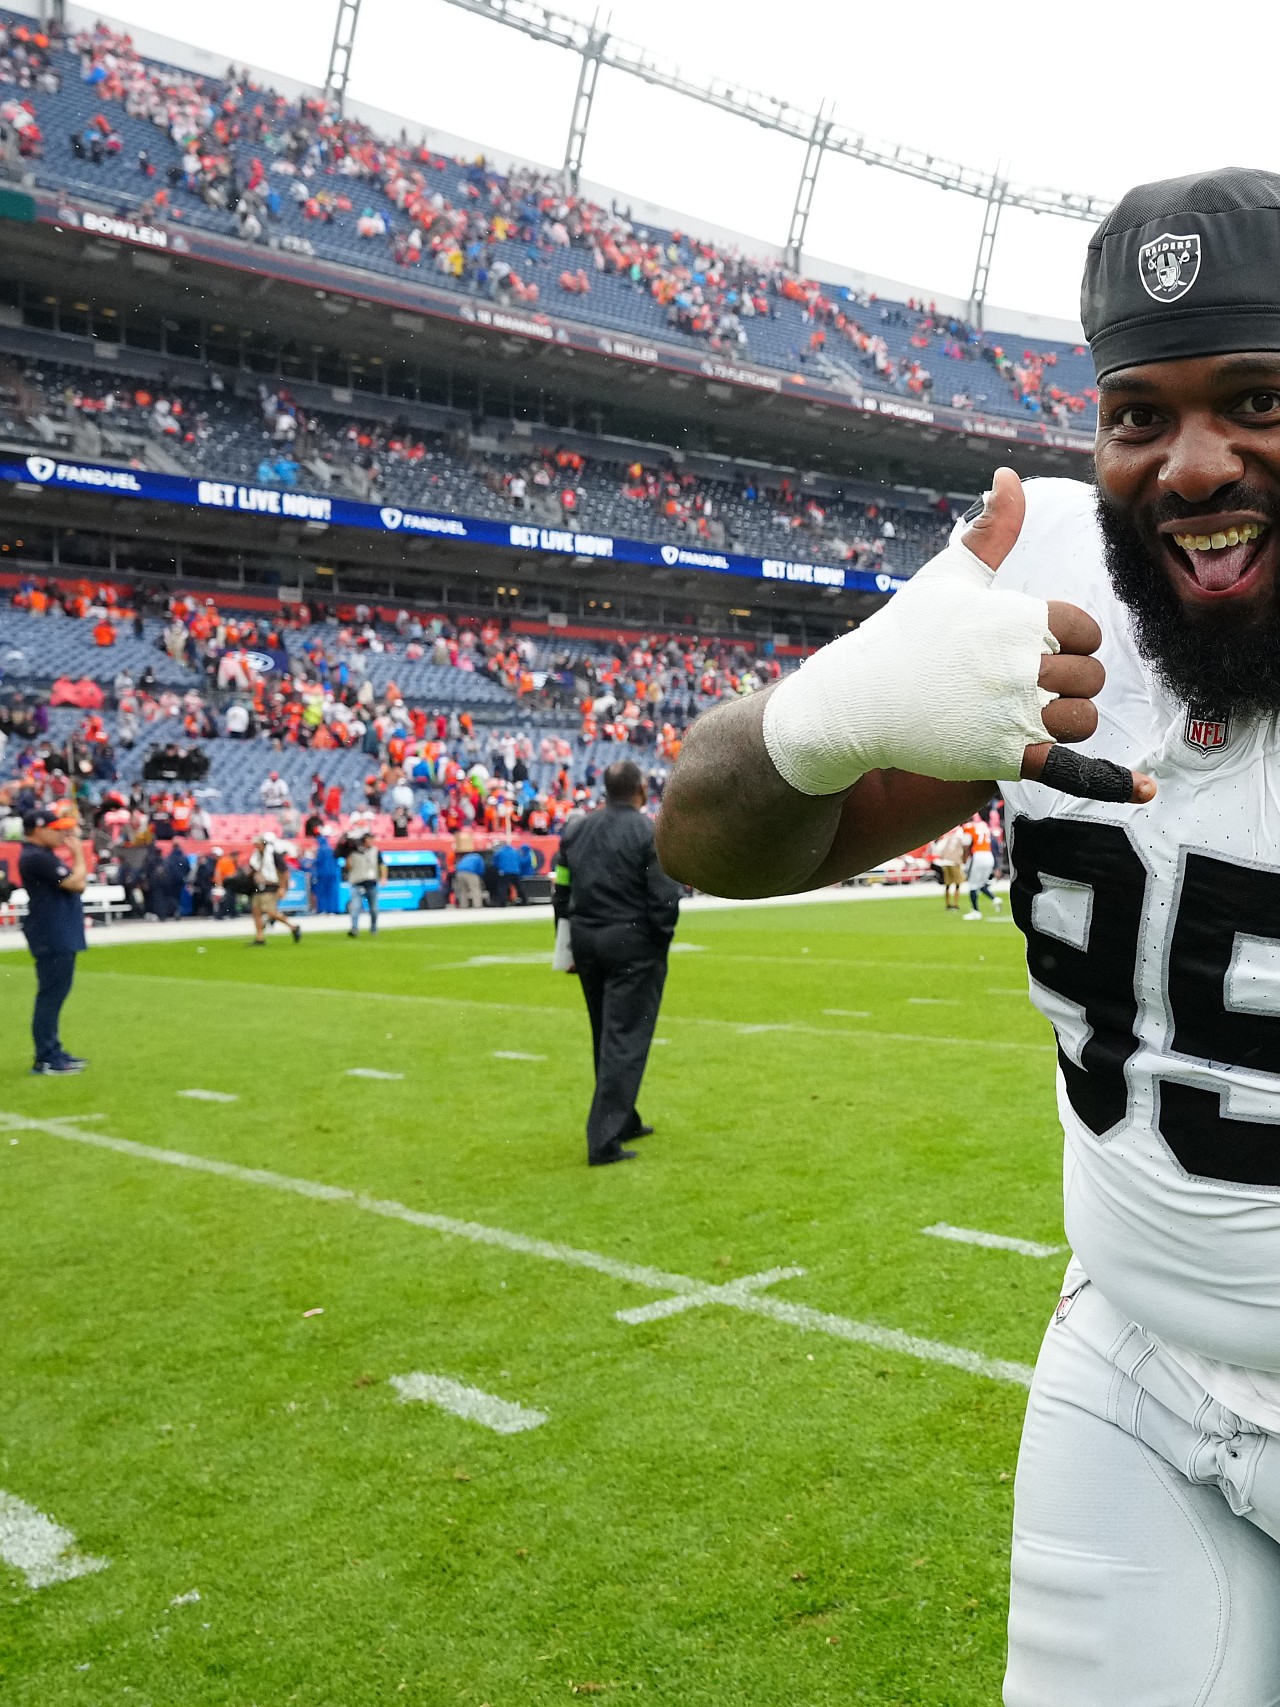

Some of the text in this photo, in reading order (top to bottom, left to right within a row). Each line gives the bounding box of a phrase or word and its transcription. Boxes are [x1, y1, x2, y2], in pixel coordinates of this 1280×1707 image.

[83, 212, 167, 248] BOWLEN
[1145, 240, 1191, 257] RAIDERS
[56, 463, 141, 491] FANDUEL
[198, 481, 332, 520] BET LIVE NOW!
[402, 514, 467, 536] FANDUEL
[509, 525, 614, 558] BET LIVE NOW!
[679, 550, 729, 569] FANDUEL
[762, 559, 786, 579] BET
[786, 563, 813, 583] LIVE
[1190, 721, 1223, 746] NFL
